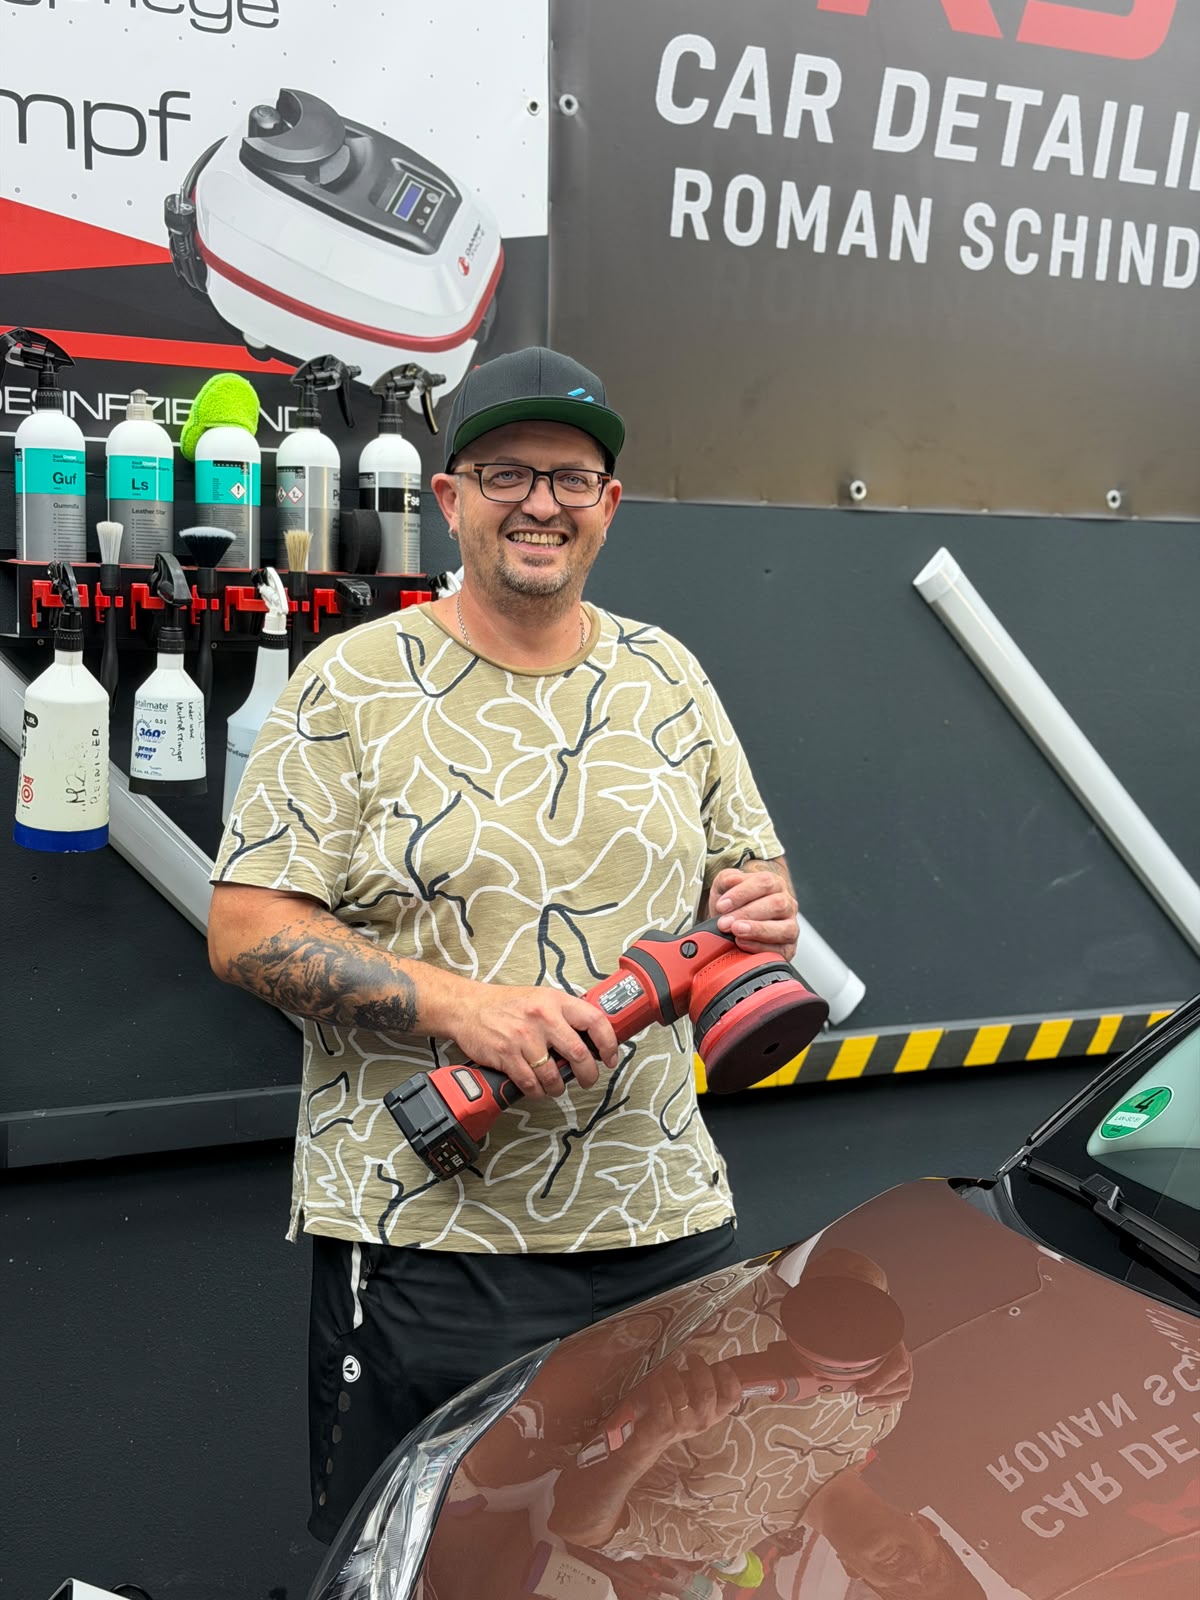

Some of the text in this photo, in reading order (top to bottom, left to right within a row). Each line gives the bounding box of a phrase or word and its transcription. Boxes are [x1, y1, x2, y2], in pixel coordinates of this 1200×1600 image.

[655, 33, 1200, 192] CAR DETAILI
[669, 167, 1200, 290] ROMAN SCHIND
[52, 471, 77, 486] Guf
[131, 477, 150, 491] Ls
[1134, 1088, 1165, 1113] 4
